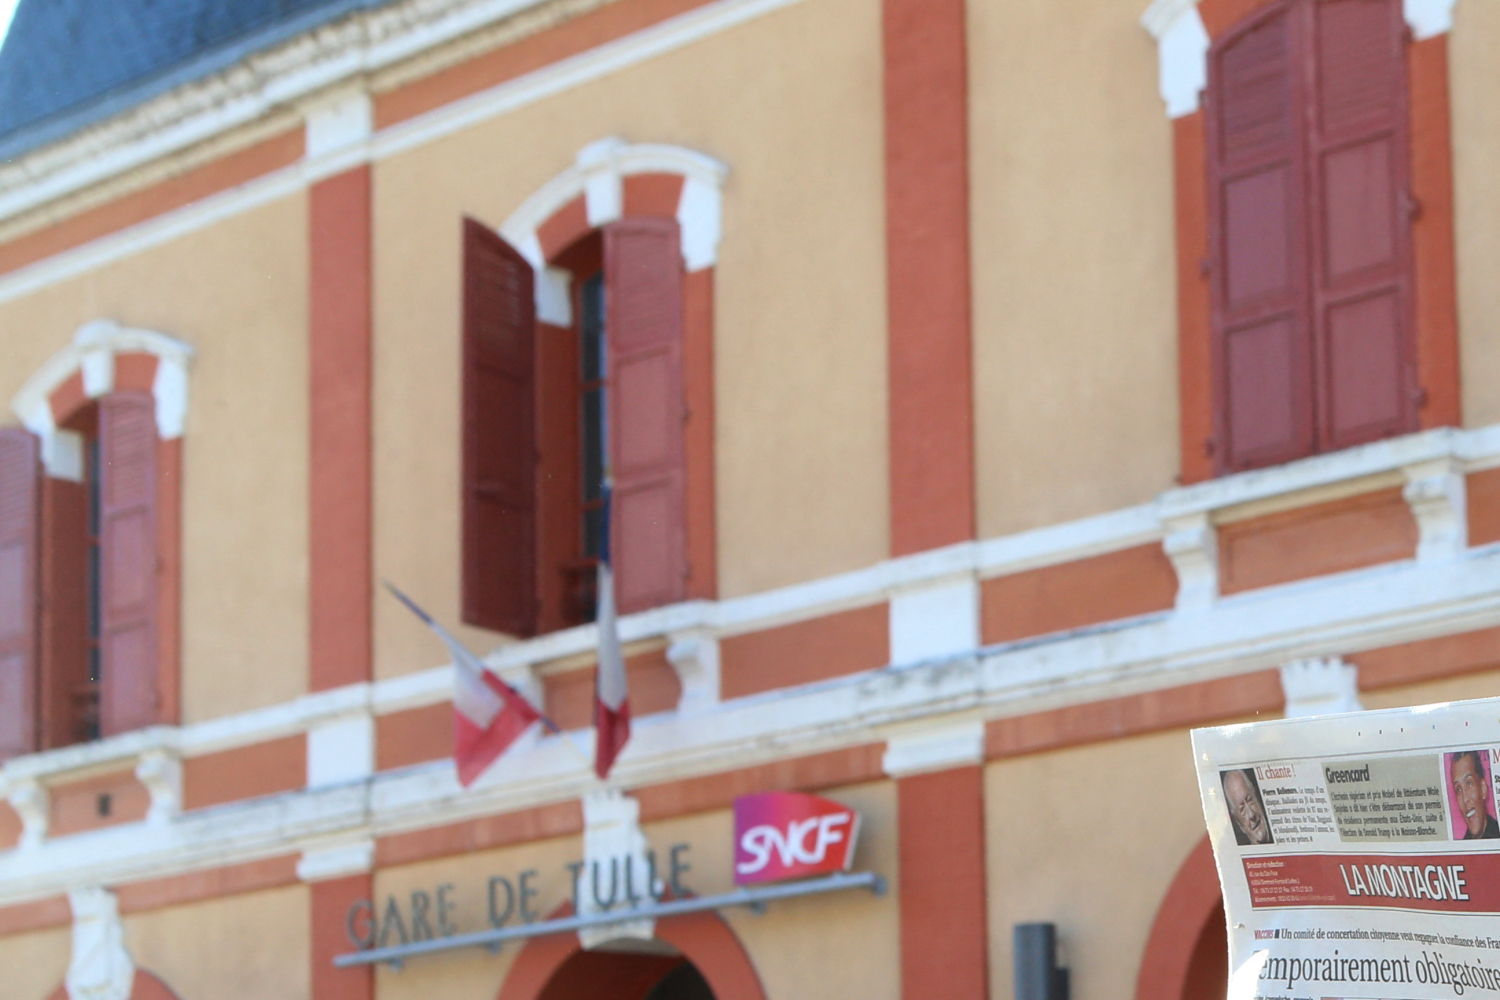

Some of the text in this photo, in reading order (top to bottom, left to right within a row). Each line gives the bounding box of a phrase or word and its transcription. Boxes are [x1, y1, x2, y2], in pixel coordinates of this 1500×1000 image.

[1325, 764, 1370, 784] Greencard
[736, 812, 850, 875] SNCF
[346, 844, 692, 949] GARE DE TULLE
[1339, 864, 1364, 896] LA
[1364, 864, 1469, 900] MONTAGNE
[1256, 950, 1412, 989] emporairement
